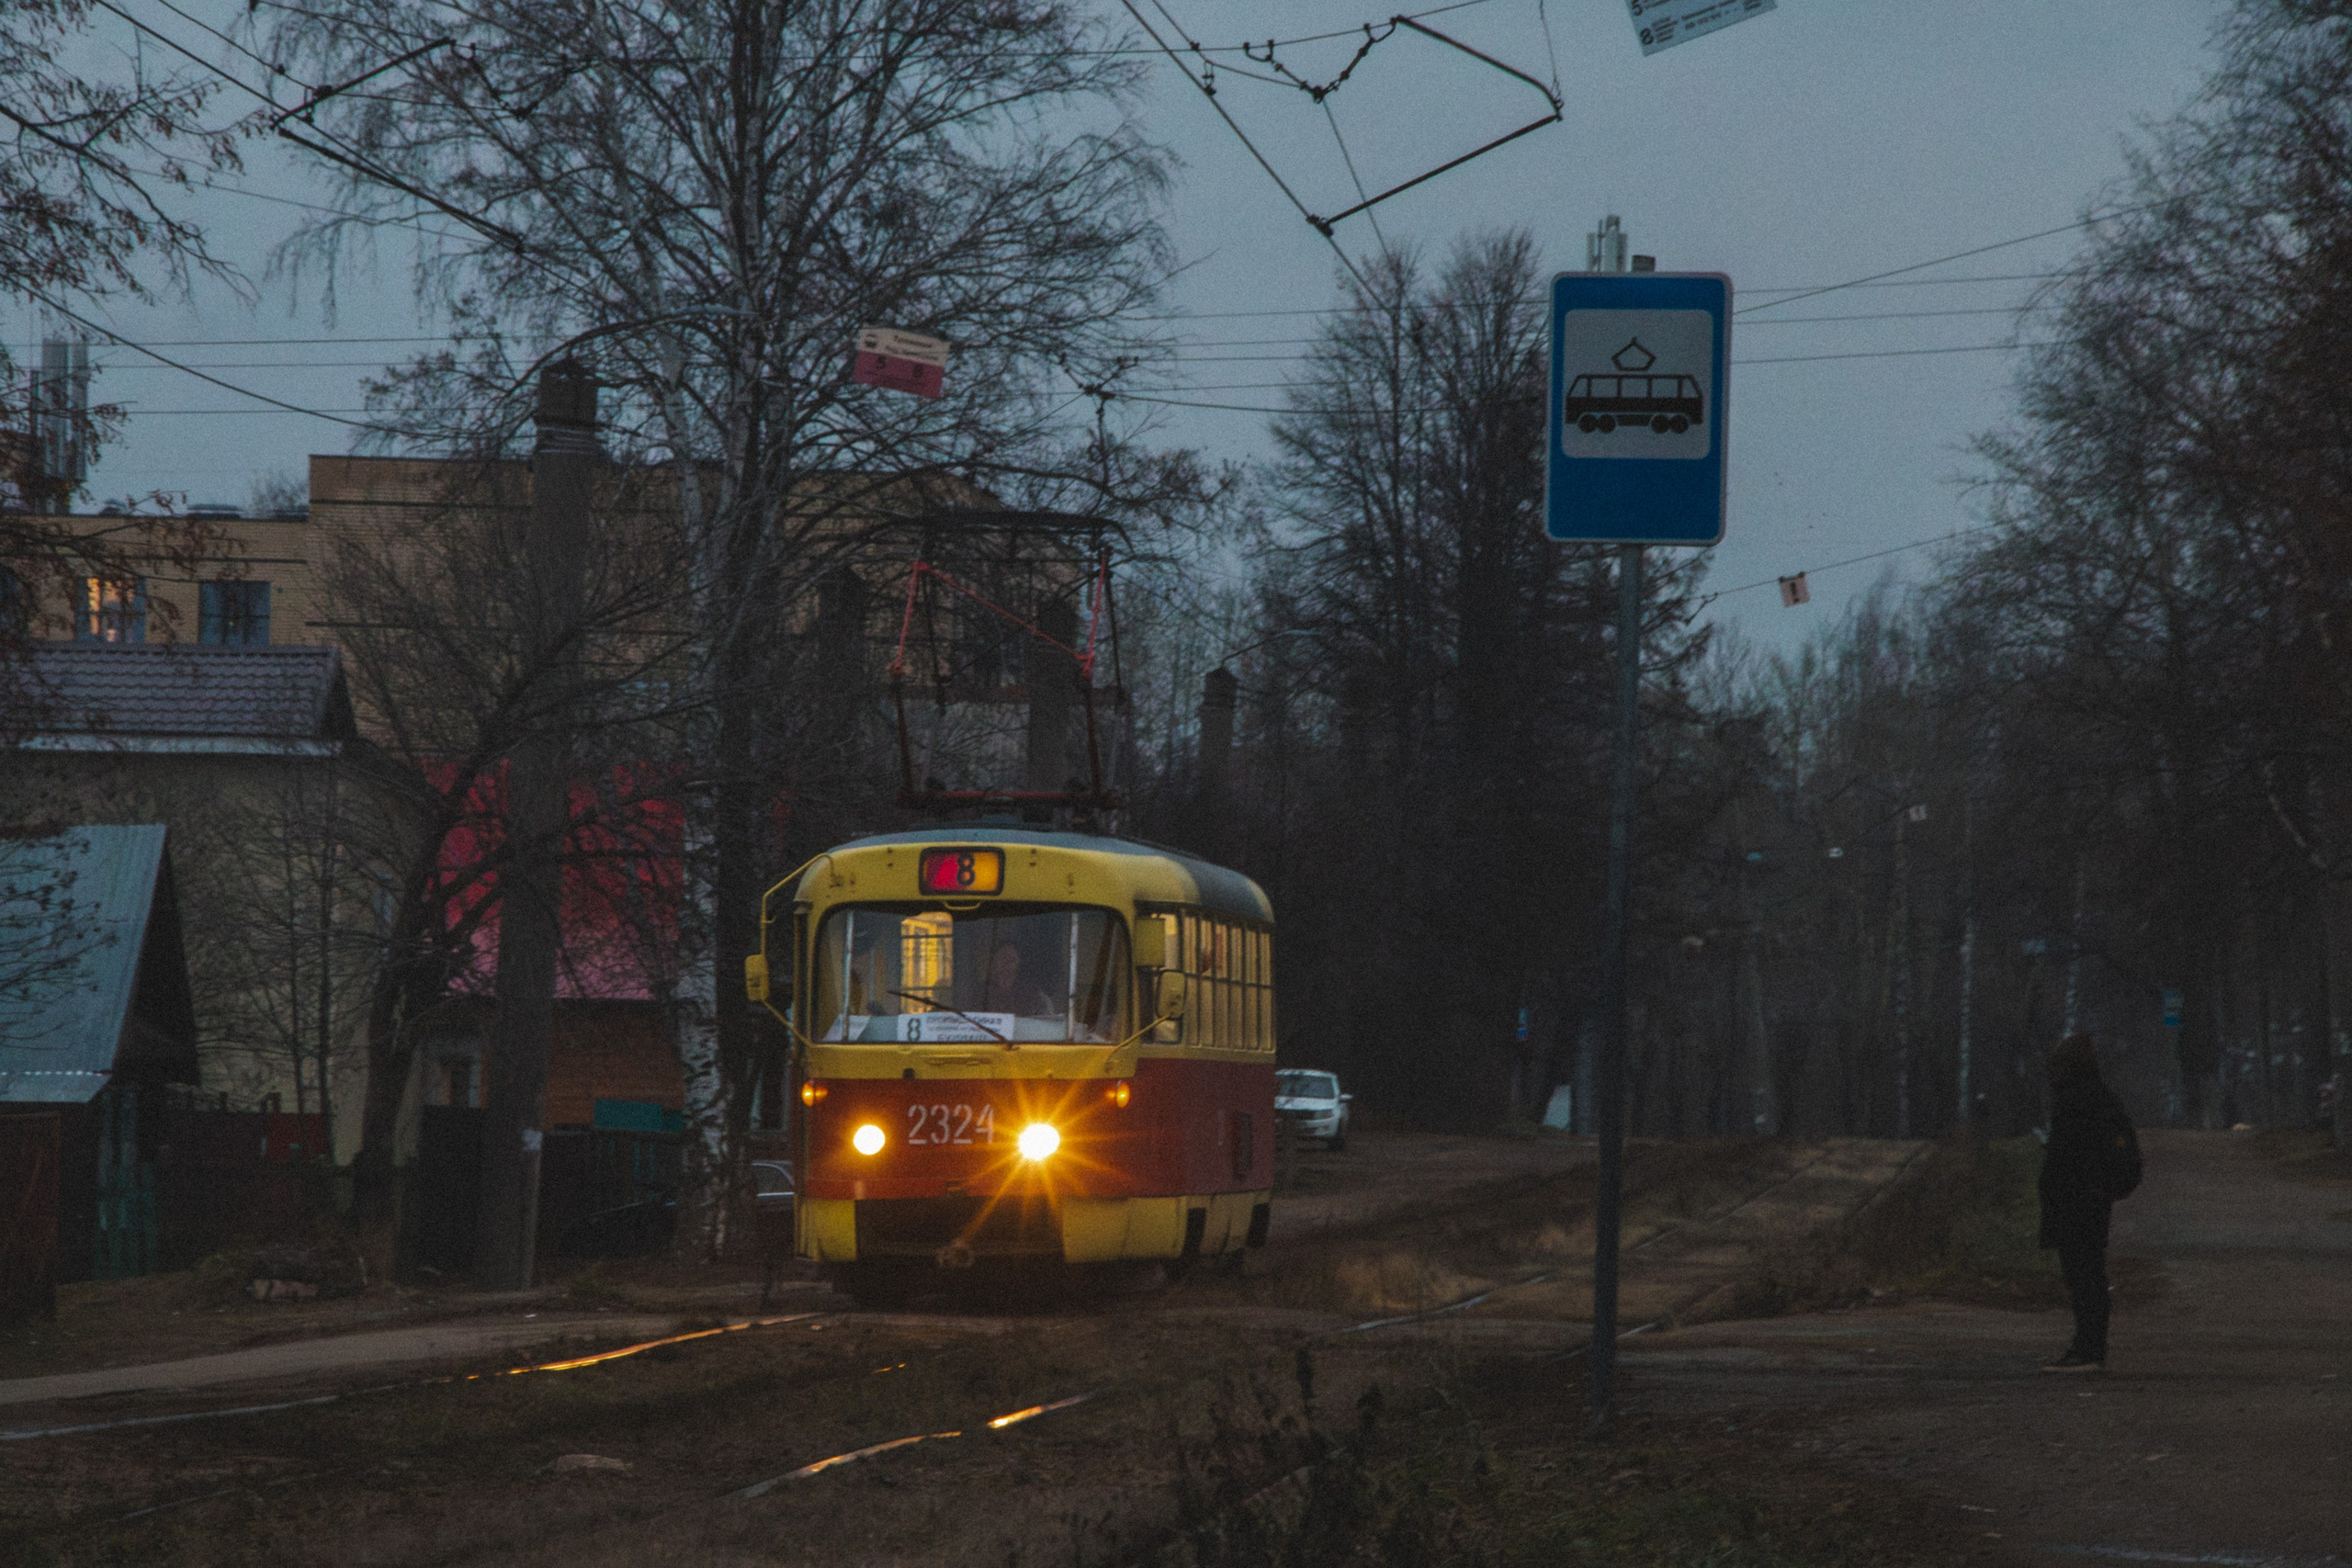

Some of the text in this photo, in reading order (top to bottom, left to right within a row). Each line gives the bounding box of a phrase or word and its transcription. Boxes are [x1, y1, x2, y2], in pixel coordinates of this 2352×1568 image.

[1640, 28, 1654, 45] 8
[957, 853, 975, 886] 8
[907, 1018, 921, 1042] 8
[909, 1104, 993, 1145] 2324
